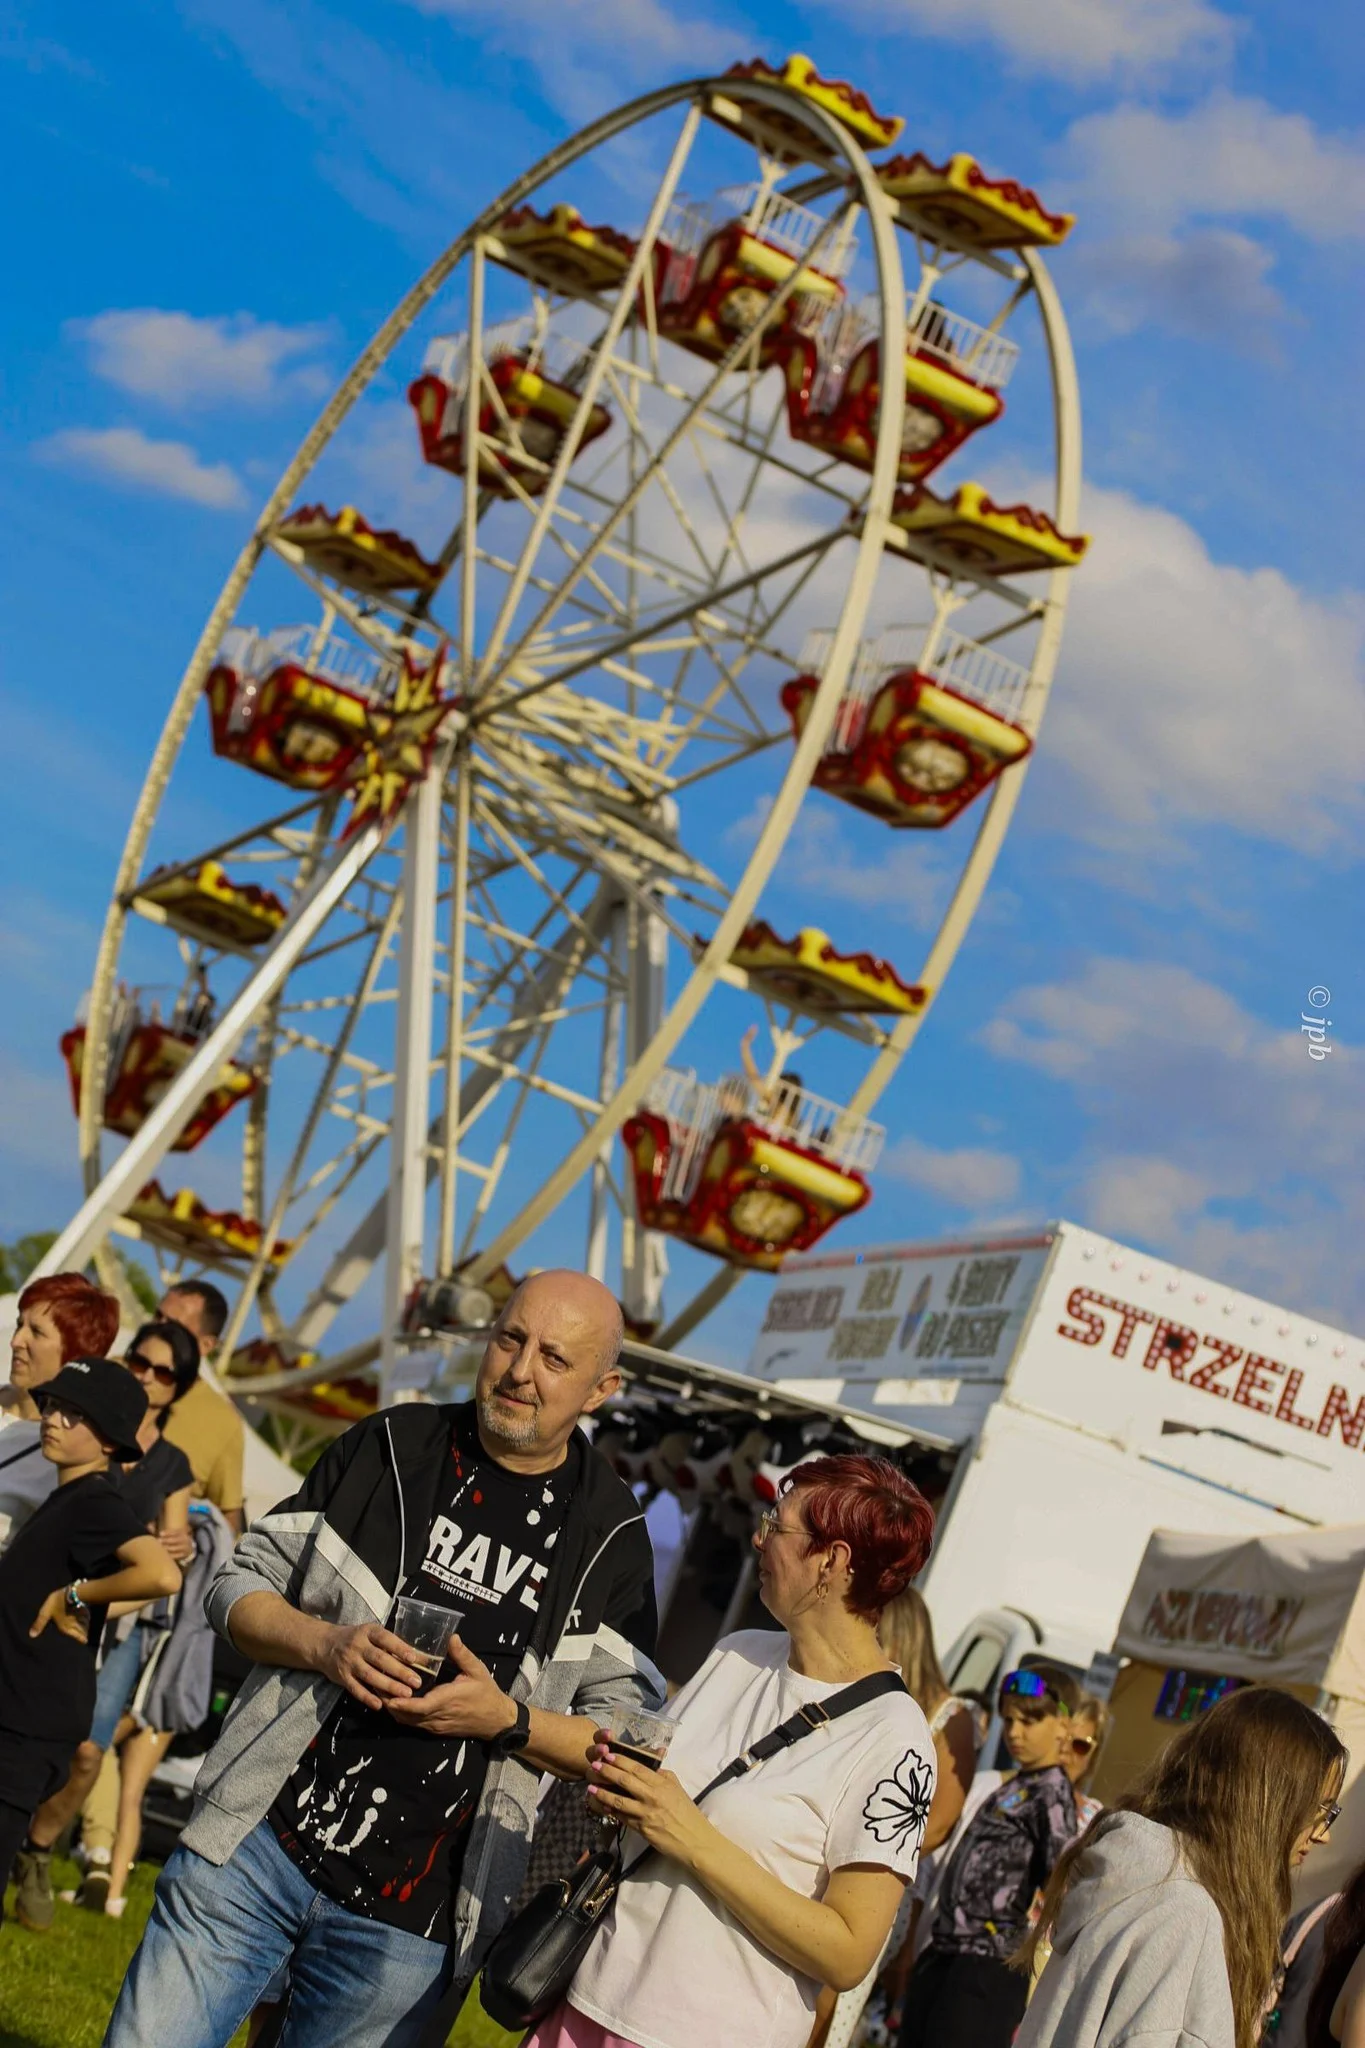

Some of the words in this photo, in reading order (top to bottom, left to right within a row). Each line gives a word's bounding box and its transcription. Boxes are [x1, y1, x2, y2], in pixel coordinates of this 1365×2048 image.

[1057, 1285, 1365, 1452] STRZELN
[426, 1563, 444, 1577] NEW
[447, 1574, 470, 1591] YORK
[474, 1585, 495, 1600] CITY
[440, 1582, 475, 1602] STREETWEAR
